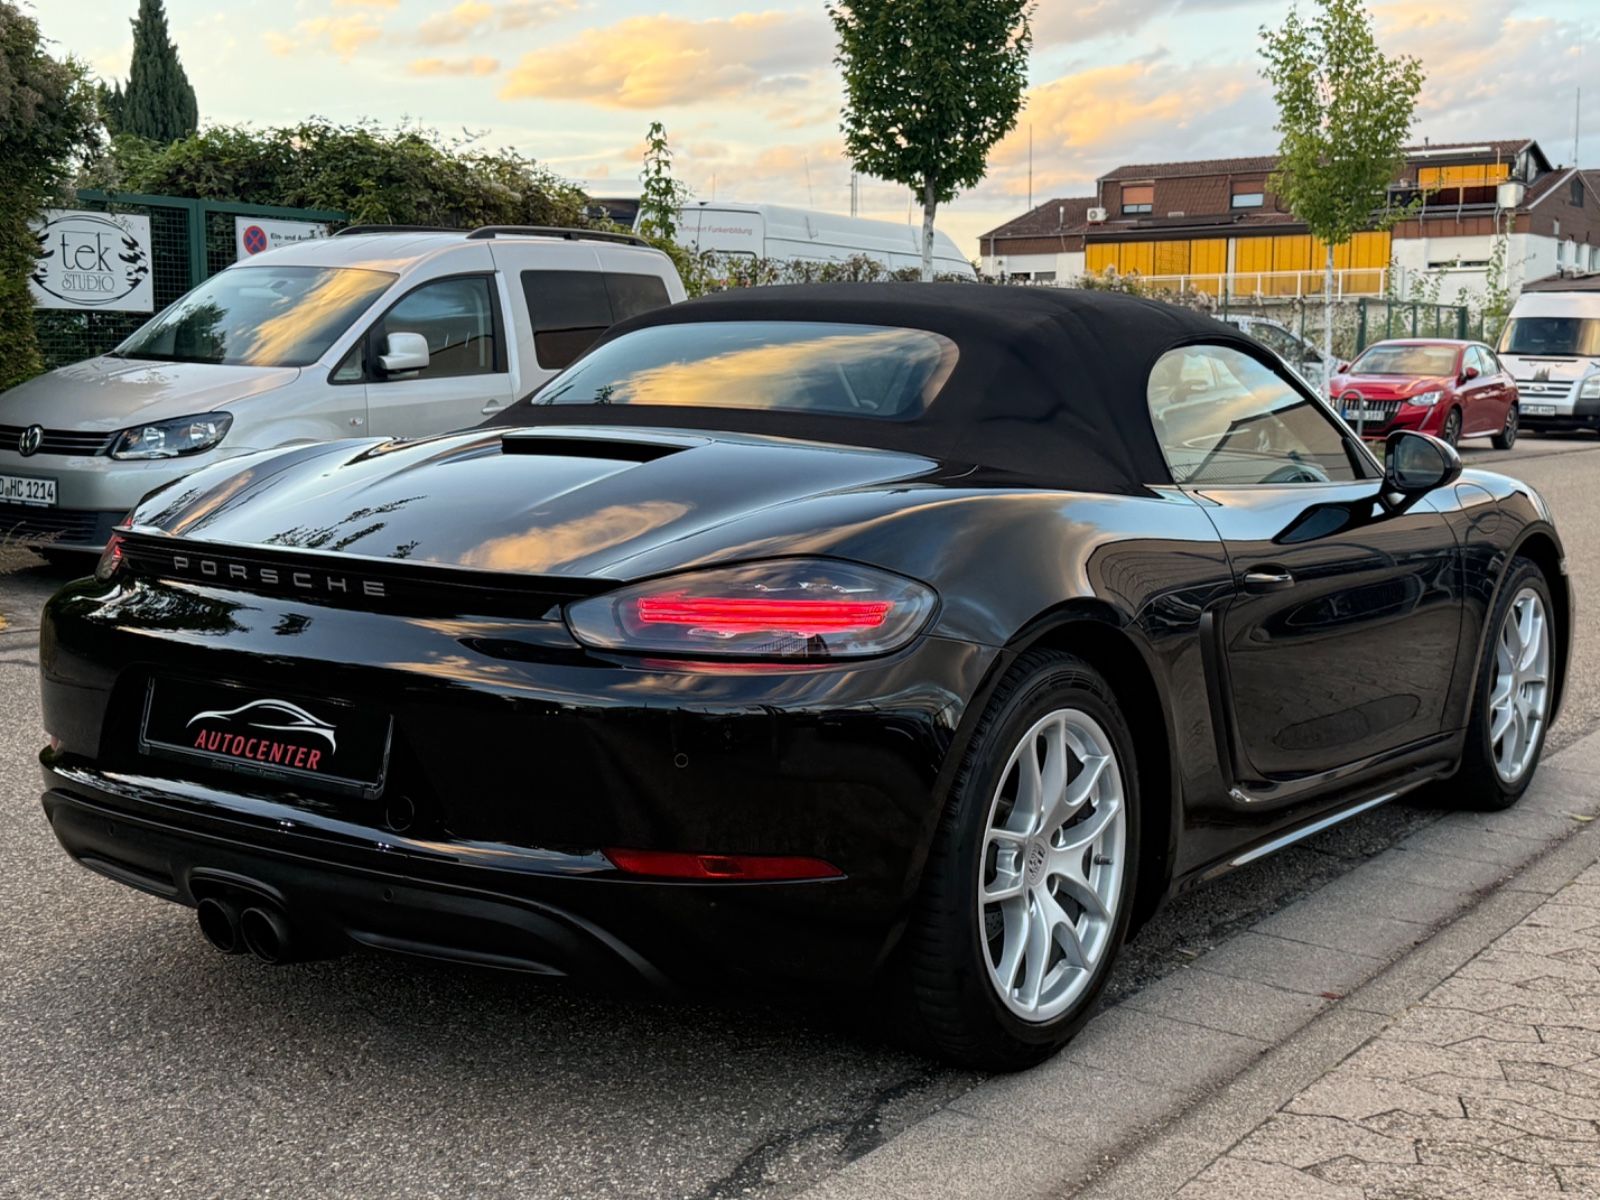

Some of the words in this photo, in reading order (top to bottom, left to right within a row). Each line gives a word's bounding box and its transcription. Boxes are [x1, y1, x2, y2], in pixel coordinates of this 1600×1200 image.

[61, 232, 113, 272] tek
[61, 274, 115, 291] STUDIO
[10, 478, 23, 497] HC
[26, 480, 54, 501] 1214
[173, 556, 385, 596] PORSCHE
[194, 729, 322, 770] AUTOCENTER
